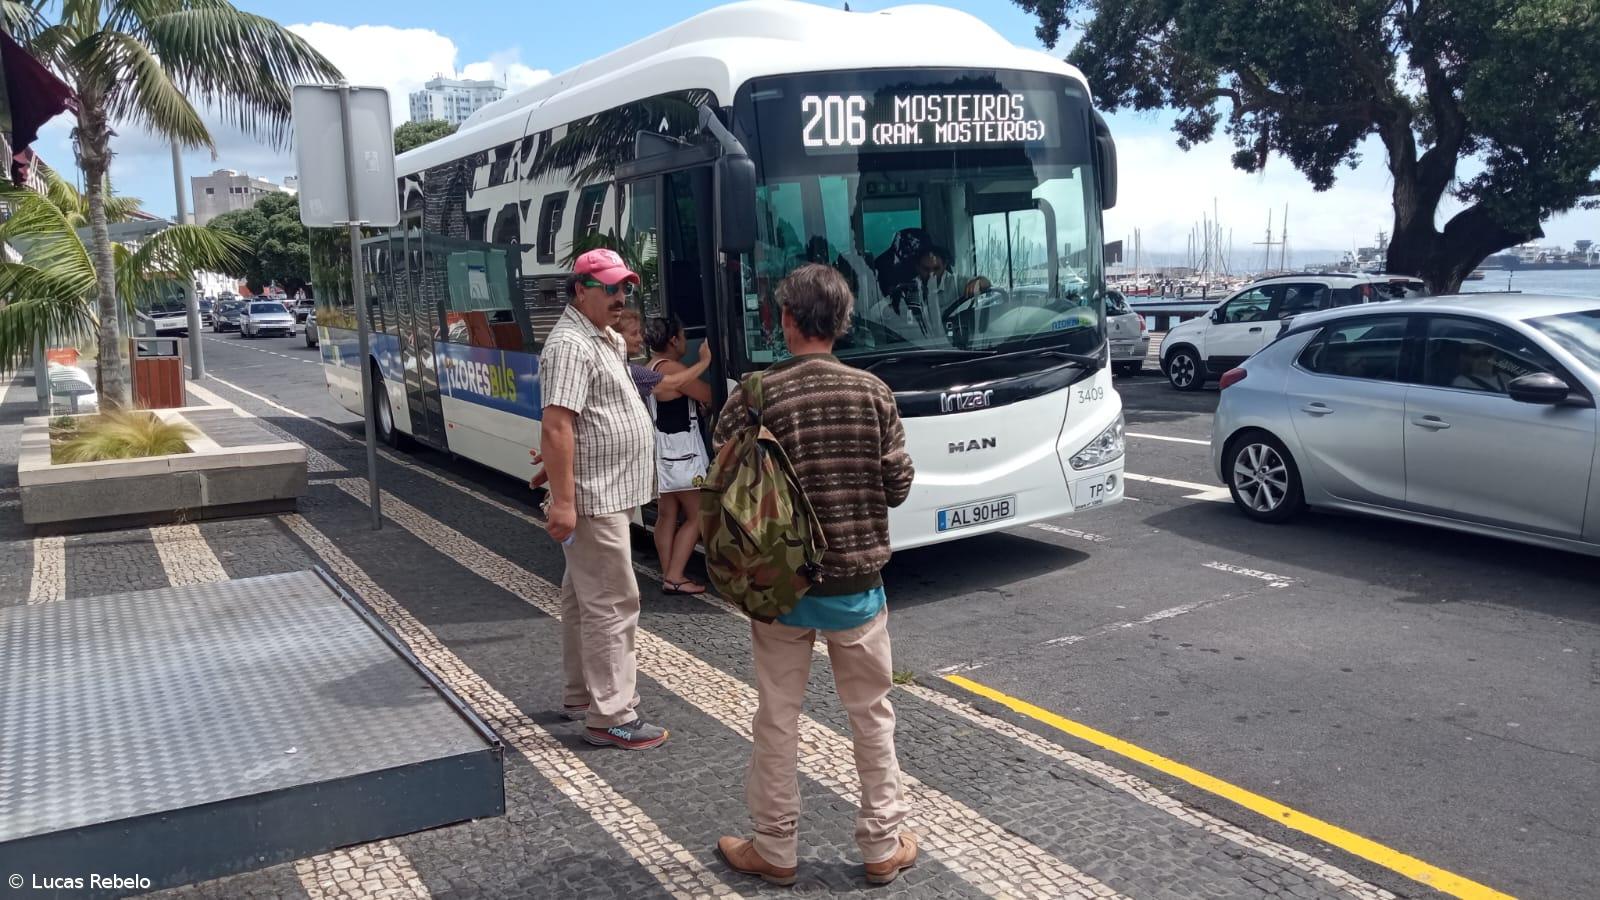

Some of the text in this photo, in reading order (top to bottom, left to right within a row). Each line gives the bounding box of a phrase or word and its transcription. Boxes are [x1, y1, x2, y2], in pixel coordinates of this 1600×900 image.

[894, 94, 1025, 123] MOSTEIROS
[802, 95, 866, 146] 206
[872, 120, 1046, 145] (RAM. MOSTEIROS)
[1077, 386, 1104, 404] 3409
[948, 436, 997, 454] MAN
[1089, 483, 1104, 498] TP
[607, 727, 632, 741] HOKA
